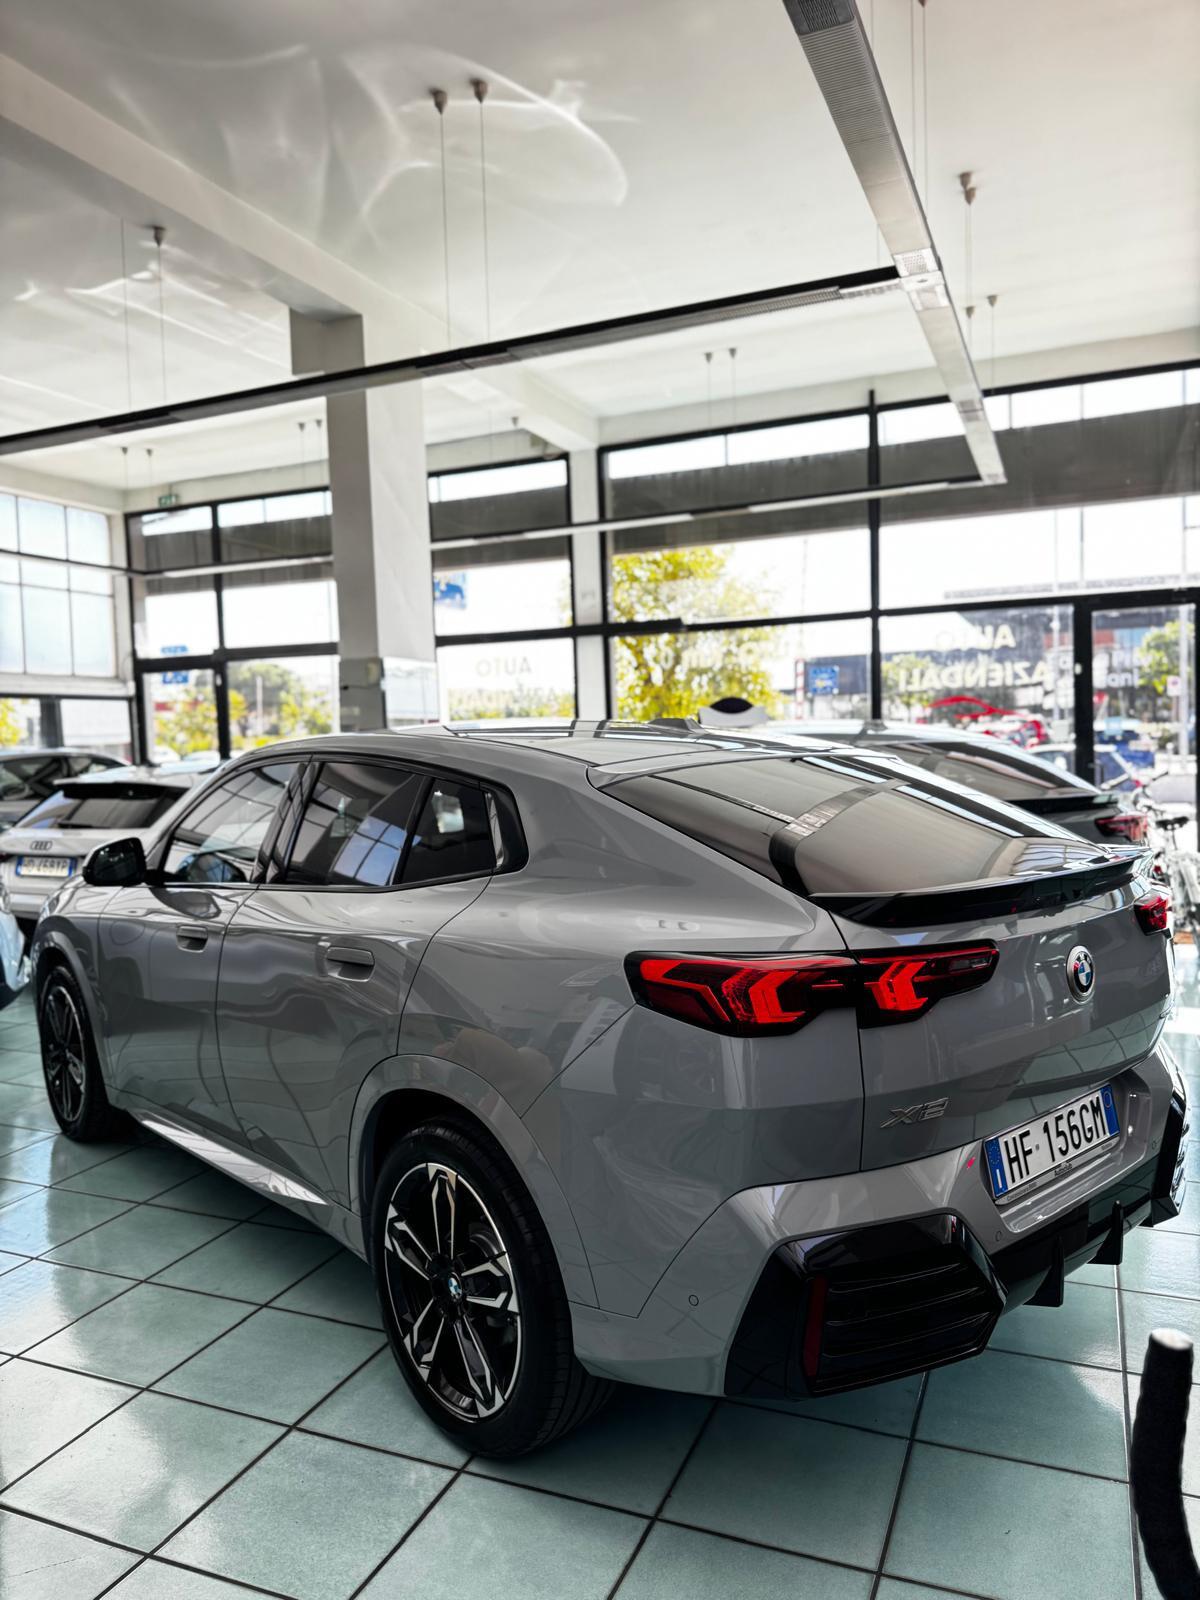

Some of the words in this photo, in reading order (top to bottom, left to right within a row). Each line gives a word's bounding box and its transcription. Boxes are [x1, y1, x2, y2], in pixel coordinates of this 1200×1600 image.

[880, 1097, 949, 1128] X2
[1004, 1129, 1033, 1184] HF
[1043, 1096, 1107, 1163] 156GM
